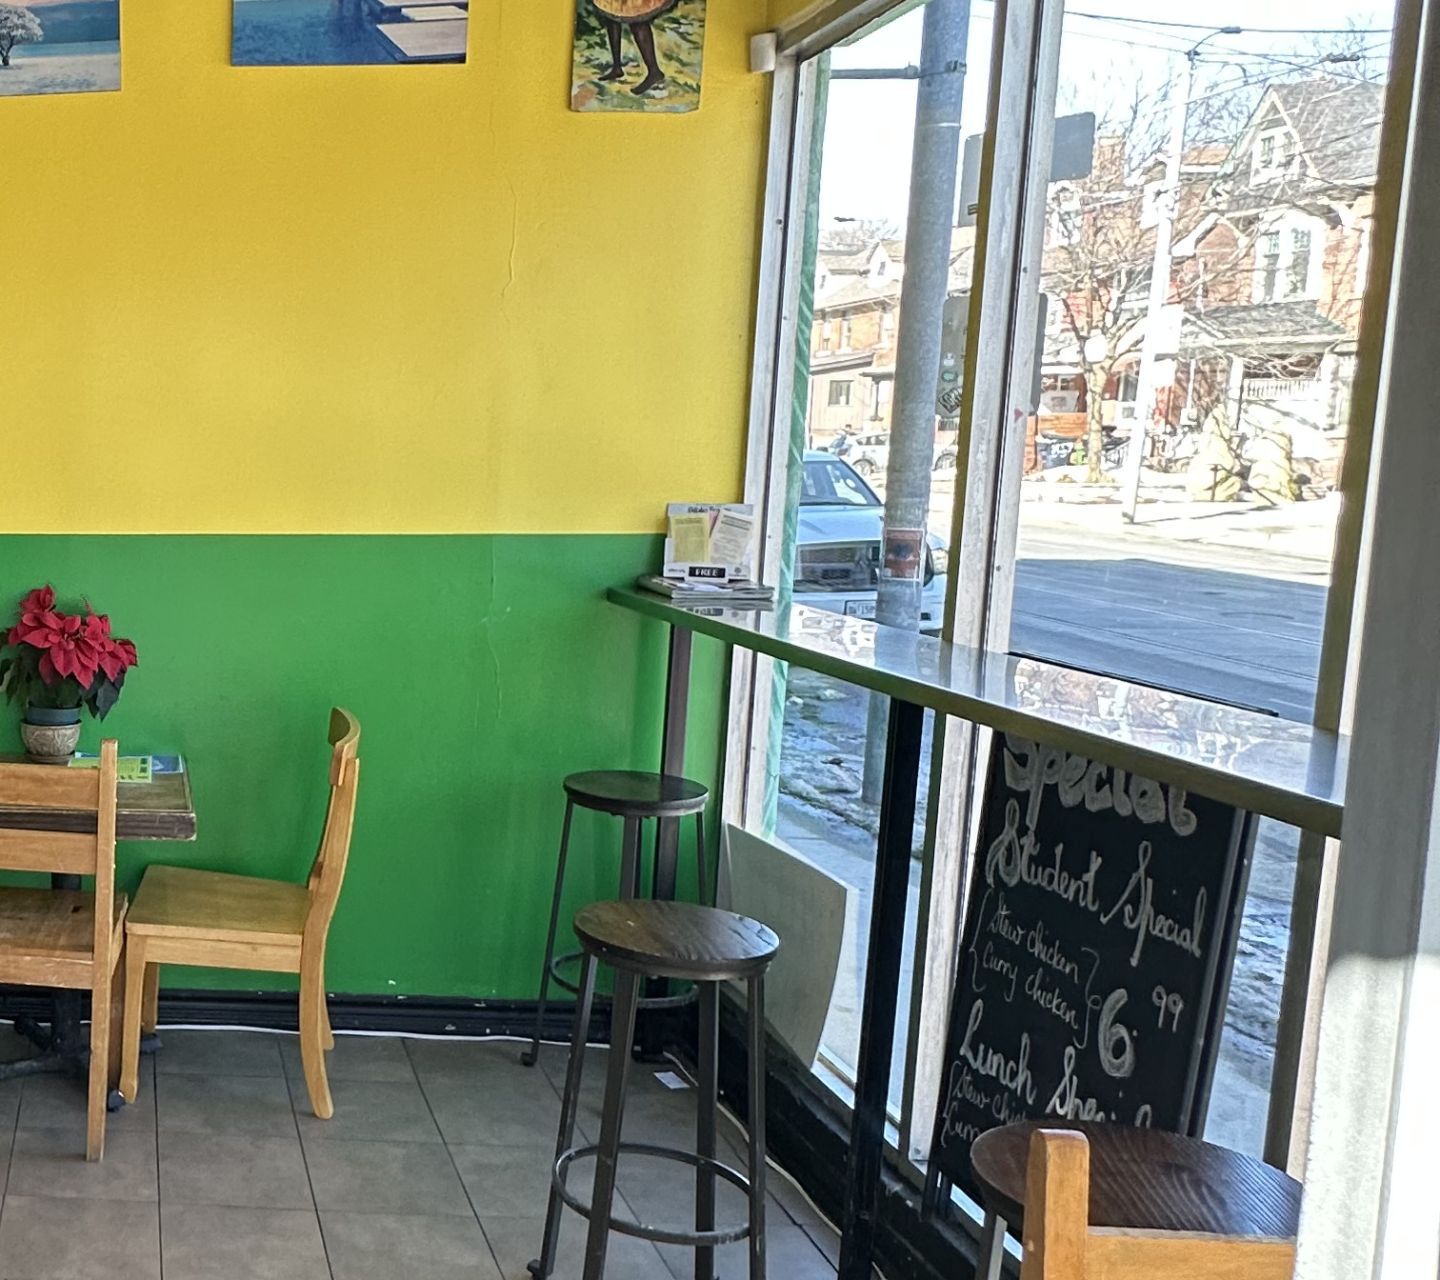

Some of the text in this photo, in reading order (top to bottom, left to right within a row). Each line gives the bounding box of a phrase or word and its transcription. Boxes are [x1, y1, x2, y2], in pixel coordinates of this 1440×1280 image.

[986, 798, 1207, 967] Student Special
[987, 892, 1079, 984] Stew chicken
[982, 941, 1079, 1030] Curry chicken
[1152, 985, 1184, 1033] 99
[960, 998, 1037, 1106] Lunch
